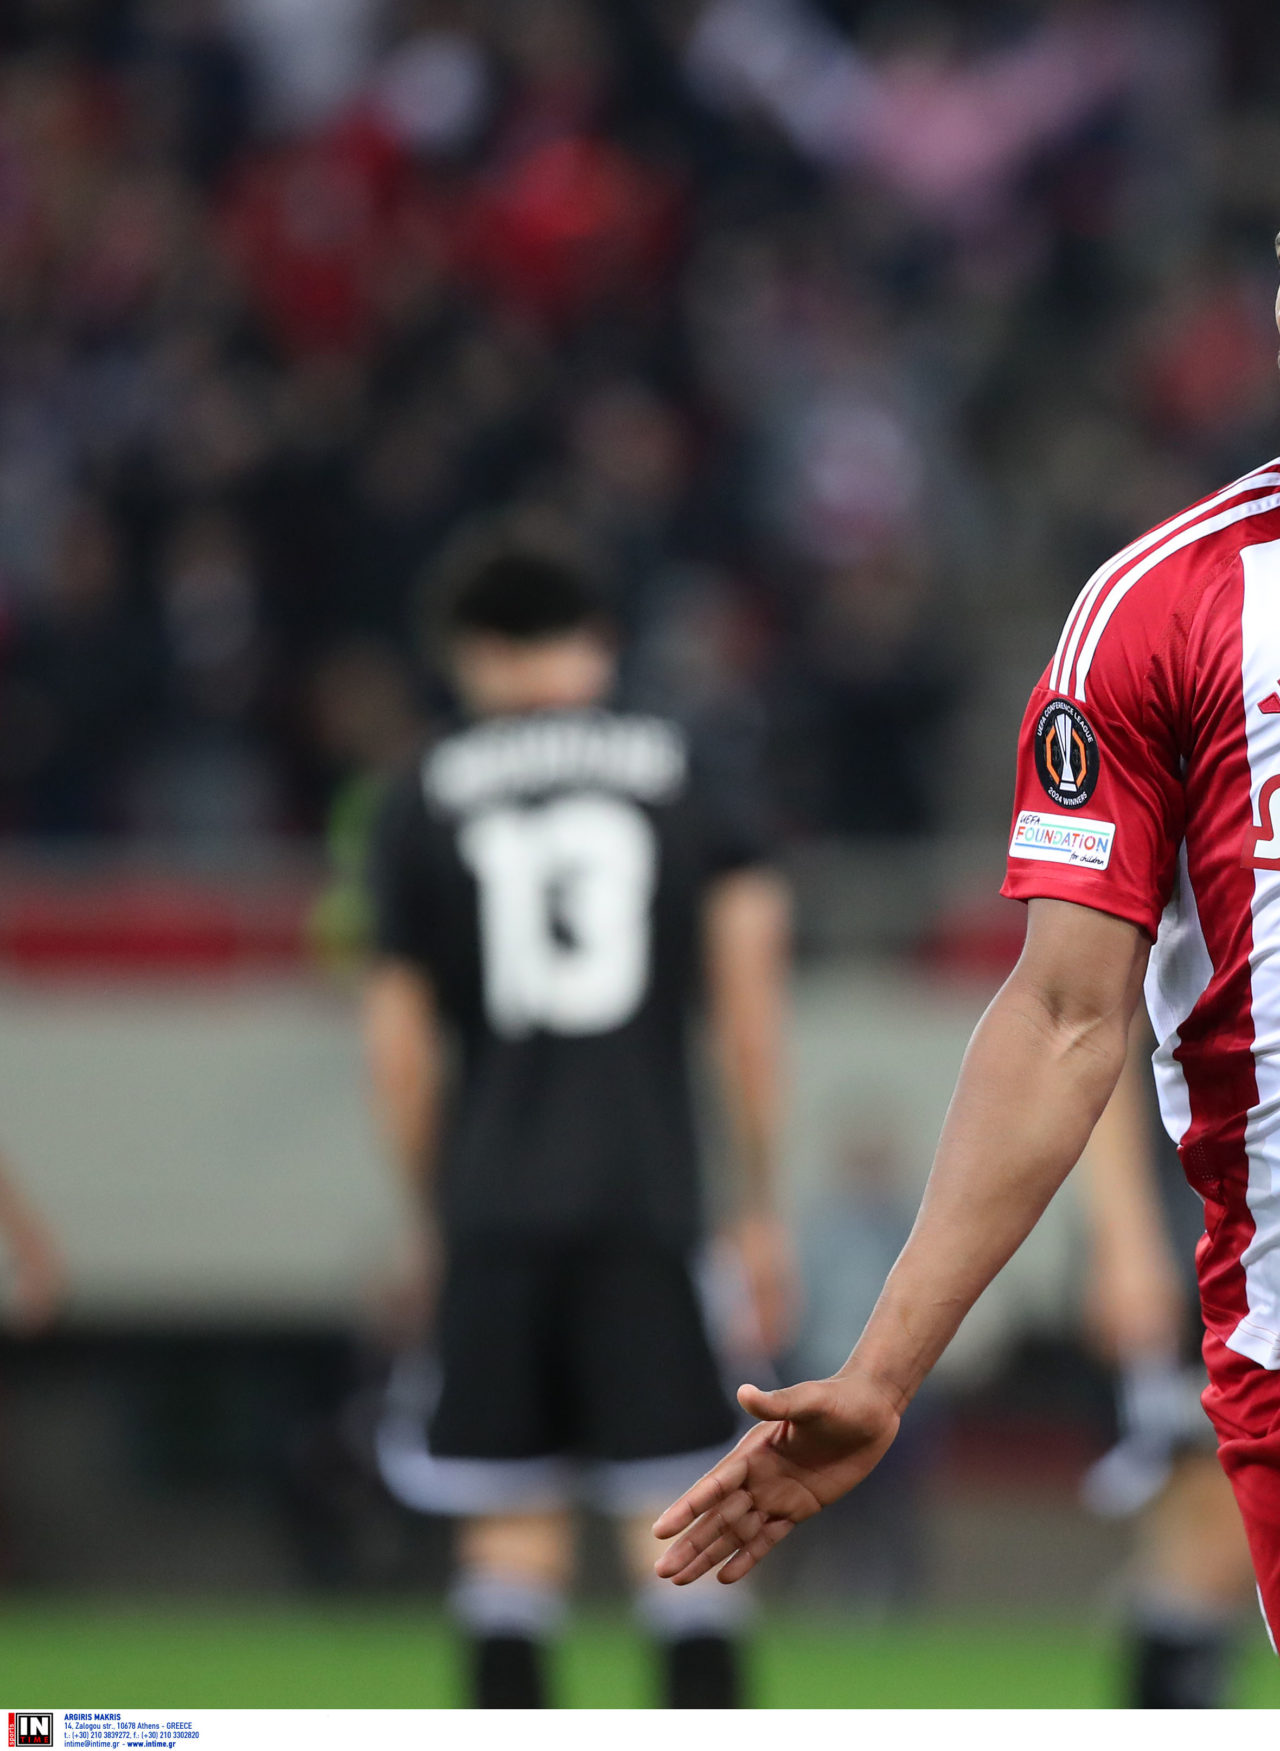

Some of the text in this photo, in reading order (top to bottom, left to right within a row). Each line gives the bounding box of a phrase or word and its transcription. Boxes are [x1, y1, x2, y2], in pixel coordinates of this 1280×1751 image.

[1037, 701, 1094, 744] UEFA CONFERENCE LEAGUE
[1047, 786, 1088, 806] 2024 WINNERS
[1019, 814, 1040, 825] UEFA
[1016, 826, 1109, 854] FOUNDATION
